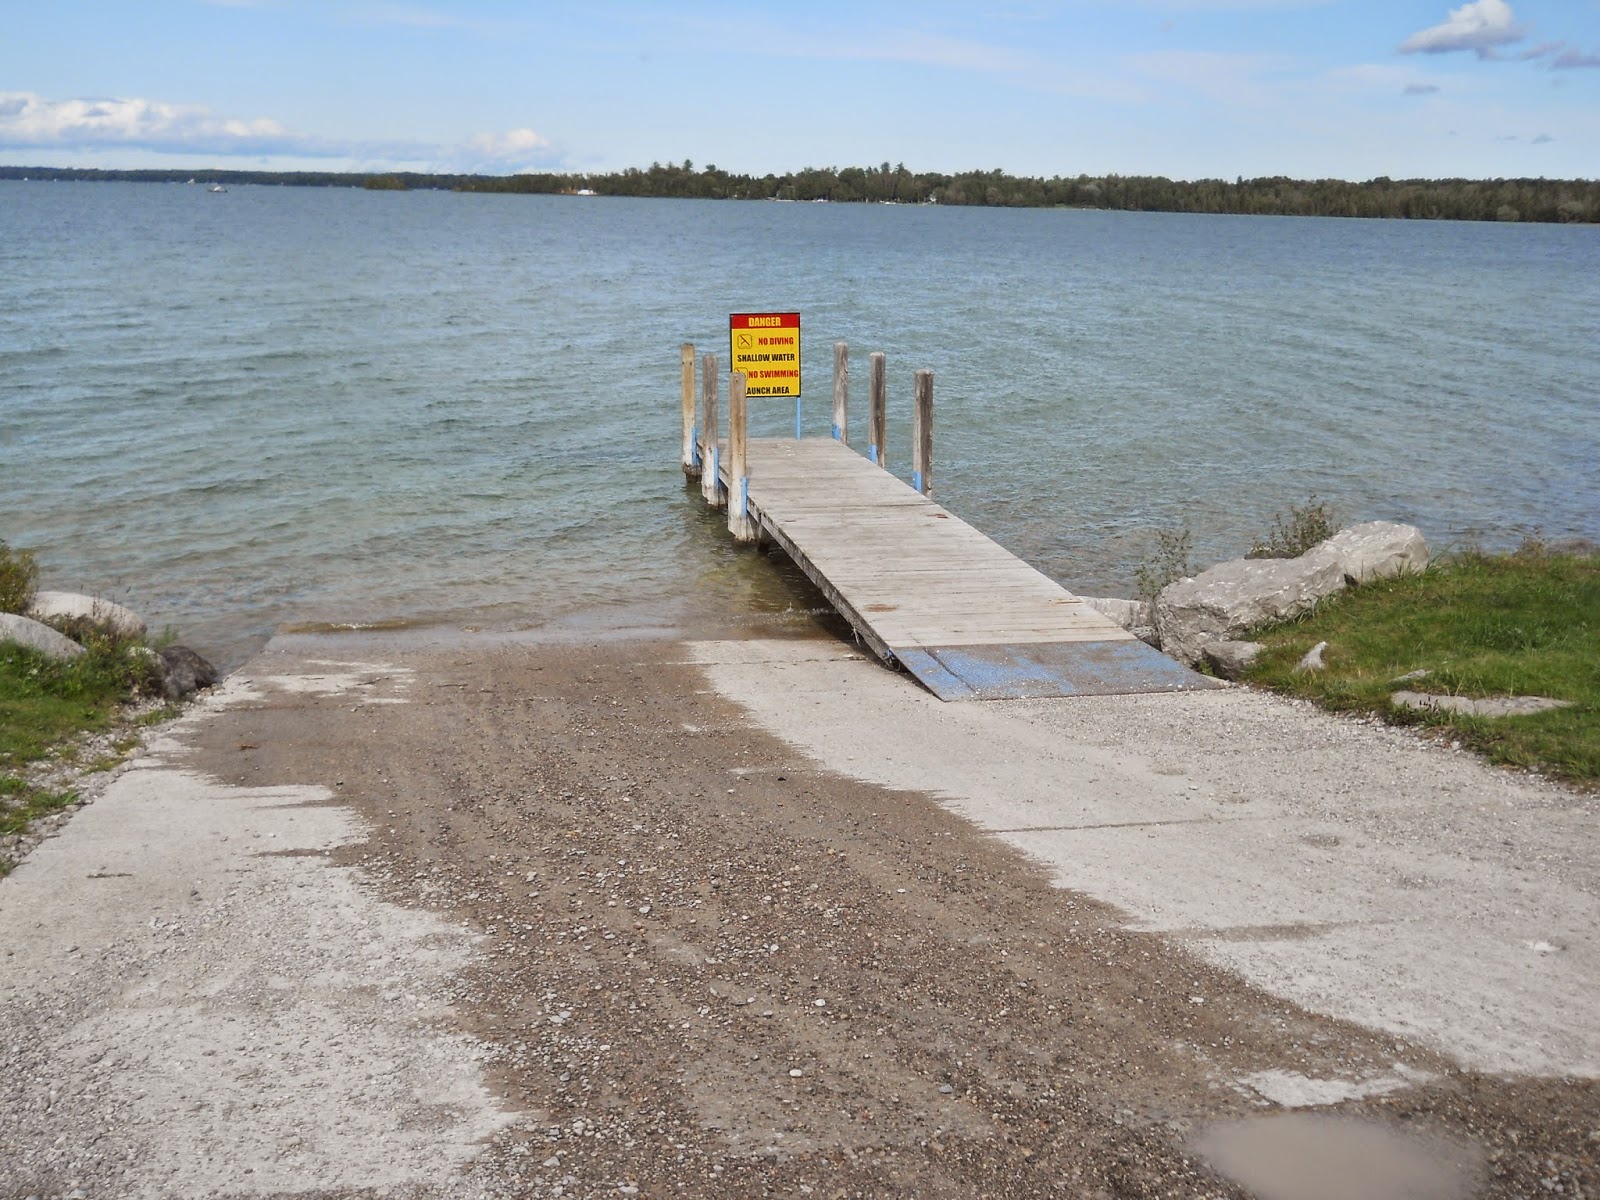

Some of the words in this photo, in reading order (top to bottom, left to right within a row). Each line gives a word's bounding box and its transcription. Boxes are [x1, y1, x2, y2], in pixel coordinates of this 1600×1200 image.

[748, 317, 781, 327] DANGER
[758, 337, 768, 345] NO
[770, 336, 794, 345] DIVING
[737, 354, 770, 362] SHALLOW
[771, 353, 795, 361] WATER
[759, 370, 799, 378] SWIMMING
[772, 386, 790, 394] AREA
